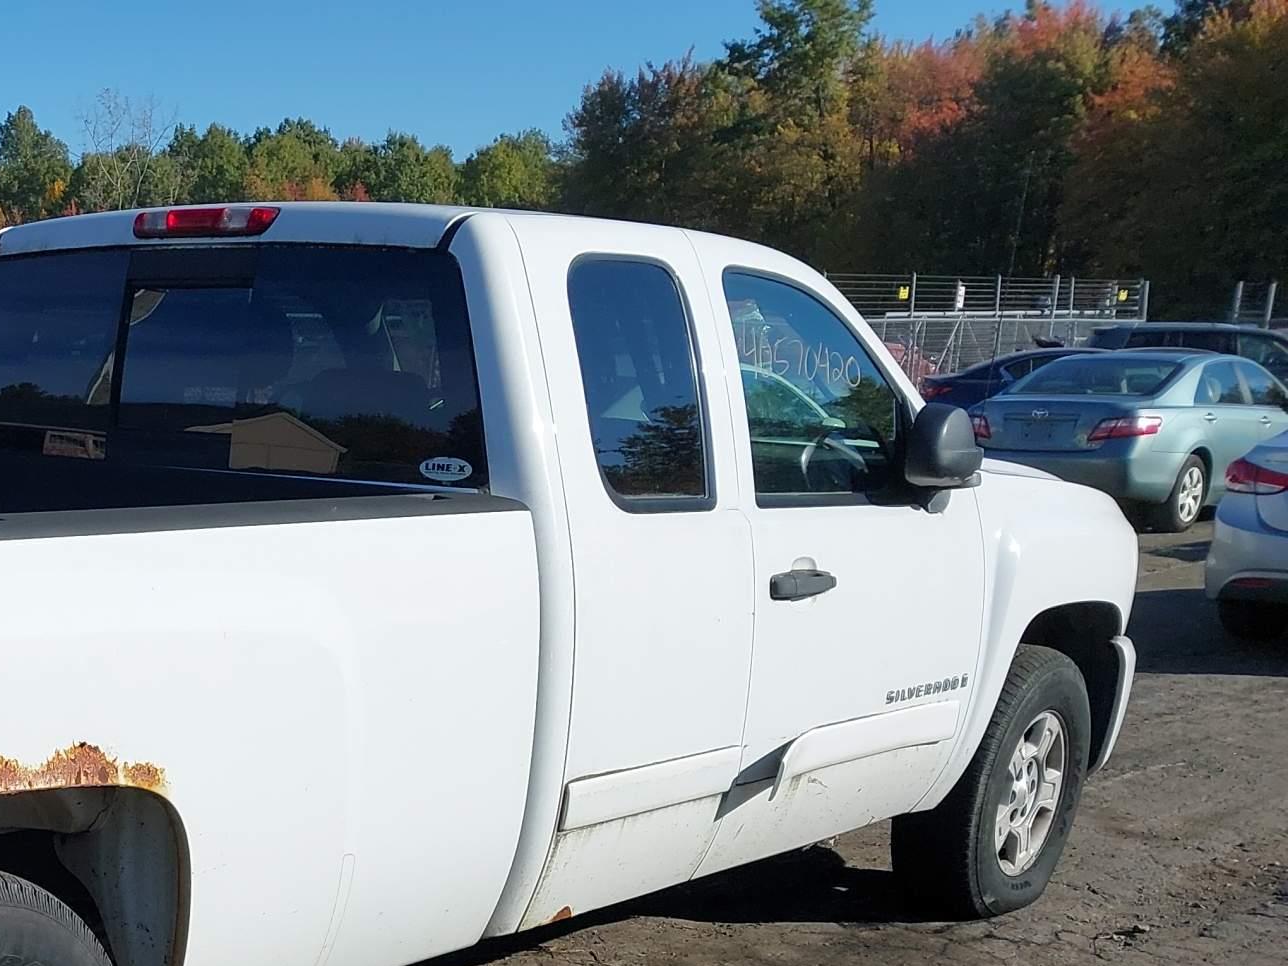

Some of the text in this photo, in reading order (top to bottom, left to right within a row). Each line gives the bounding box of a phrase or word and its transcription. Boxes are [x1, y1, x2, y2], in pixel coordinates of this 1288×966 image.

[743, 320, 861, 388] 40570420
[424, 463, 466, 473] LINE-X
[885, 676, 960, 705] SILVERADO
